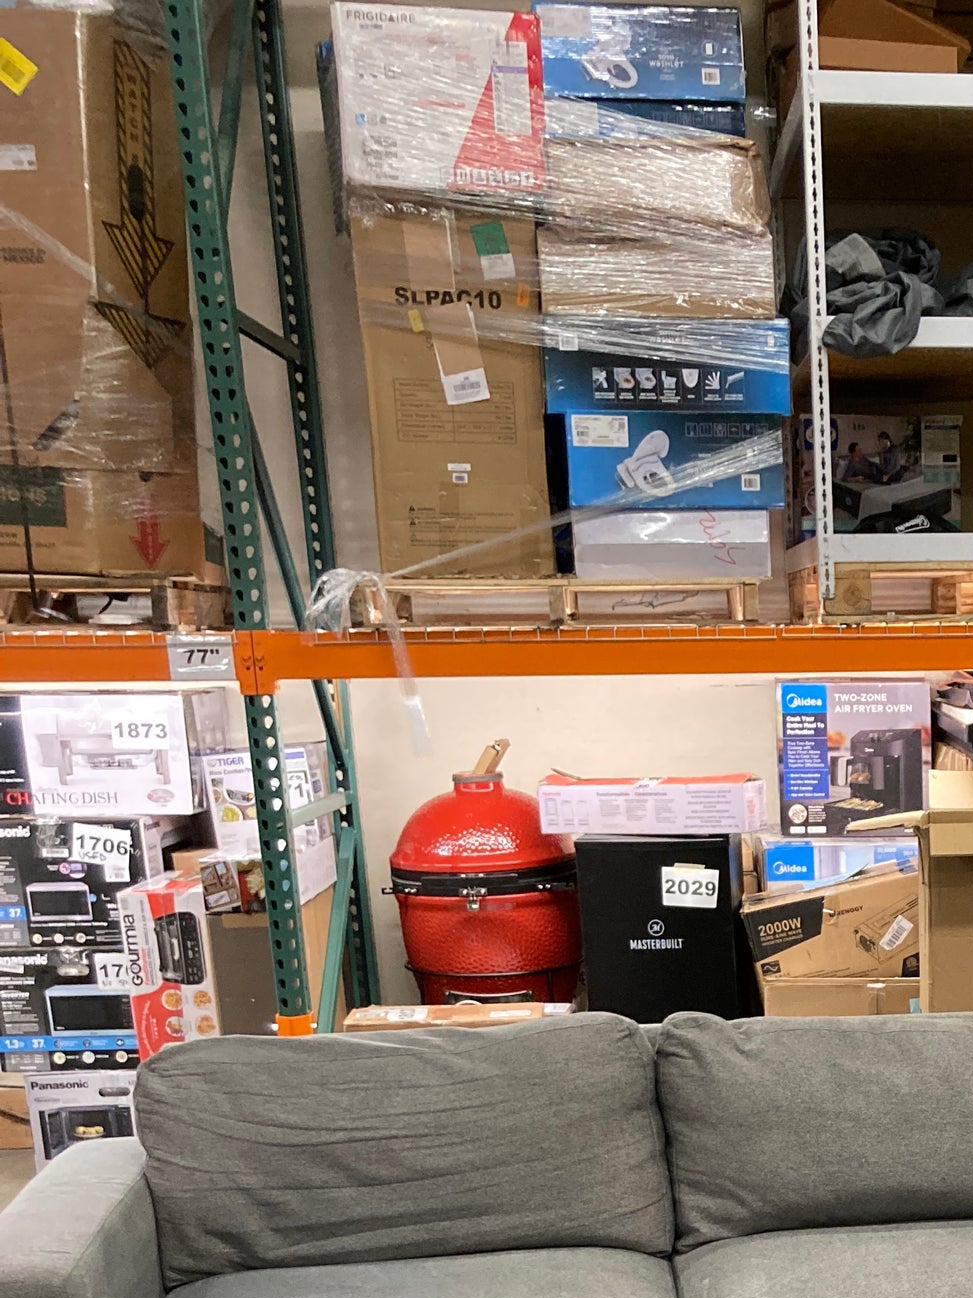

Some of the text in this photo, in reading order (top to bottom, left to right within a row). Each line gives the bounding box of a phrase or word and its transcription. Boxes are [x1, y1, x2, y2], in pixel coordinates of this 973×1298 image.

[394, 286, 502, 310] SLPAC10
[786, 693, 823, 708] Midea
[833, 693, 887, 702] TWO-ZONE
[834, 704, 913, 713] AIR FRYER OVEN
[114, 722, 168, 739] 1873
[216, 756, 245, 767] TIGER
[82, 791, 119, 804] DISH
[76, 834, 129, 856] 1706
[773, 861, 808, 875] Midea
[664, 879, 716, 897] 2029
[757, 917, 801, 937] 2000W
[123, 914, 143, 987] Gourmia
[629, 938, 685, 950] MASTERBUILT
[99, 964, 129, 978] 17
[30, 1079, 89, 1091] Panasonic
